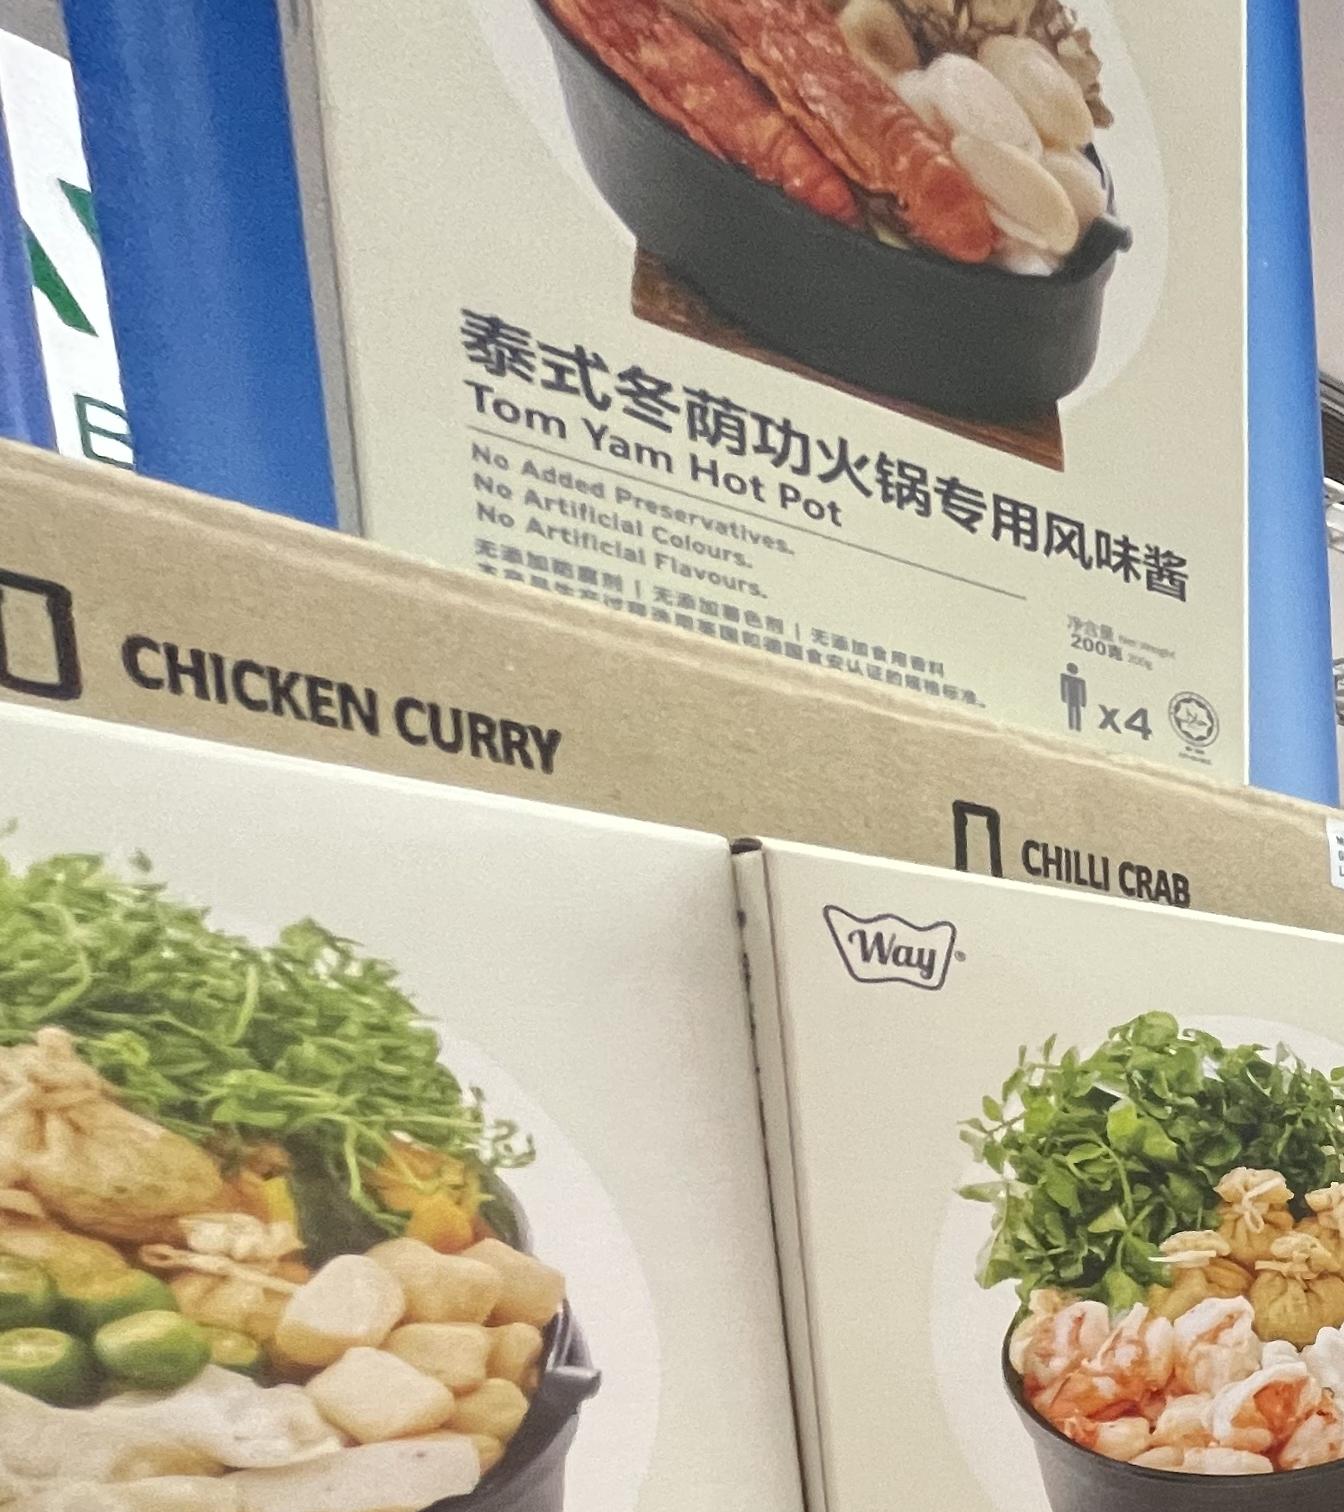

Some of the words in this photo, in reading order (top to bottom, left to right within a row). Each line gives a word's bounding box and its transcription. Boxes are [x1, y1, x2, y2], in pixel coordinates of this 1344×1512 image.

[461, 307, 1188, 602] 泰式冬荫功火锅专用风味酱
[463, 379, 567, 440] Tom
[582, 416, 674, 475] Yam
[689, 452, 766, 503] Hot
[779, 482, 844, 530] Pot
[471, 442, 510, 472] No
[522, 459, 606, 500] Added
[615, 485, 796, 556] Preservatives.
[473, 472, 513, 501] No
[524, 488, 644, 538] Artificial
[652, 524, 754, 570] Colours.
[476, 501, 516, 529] No
[525, 516, 647, 567] Artificial
[655, 552, 769, 600] Flavours.
[121, 634, 381, 736] CHICKEN
[393, 695, 563, 775] CURRY
[1098, 702, 1154, 742] x4
[1020, 839, 1110, 892] CHILLI
[1119, 860, 1192, 908] CRAB
[848, 929, 937, 980] Way
